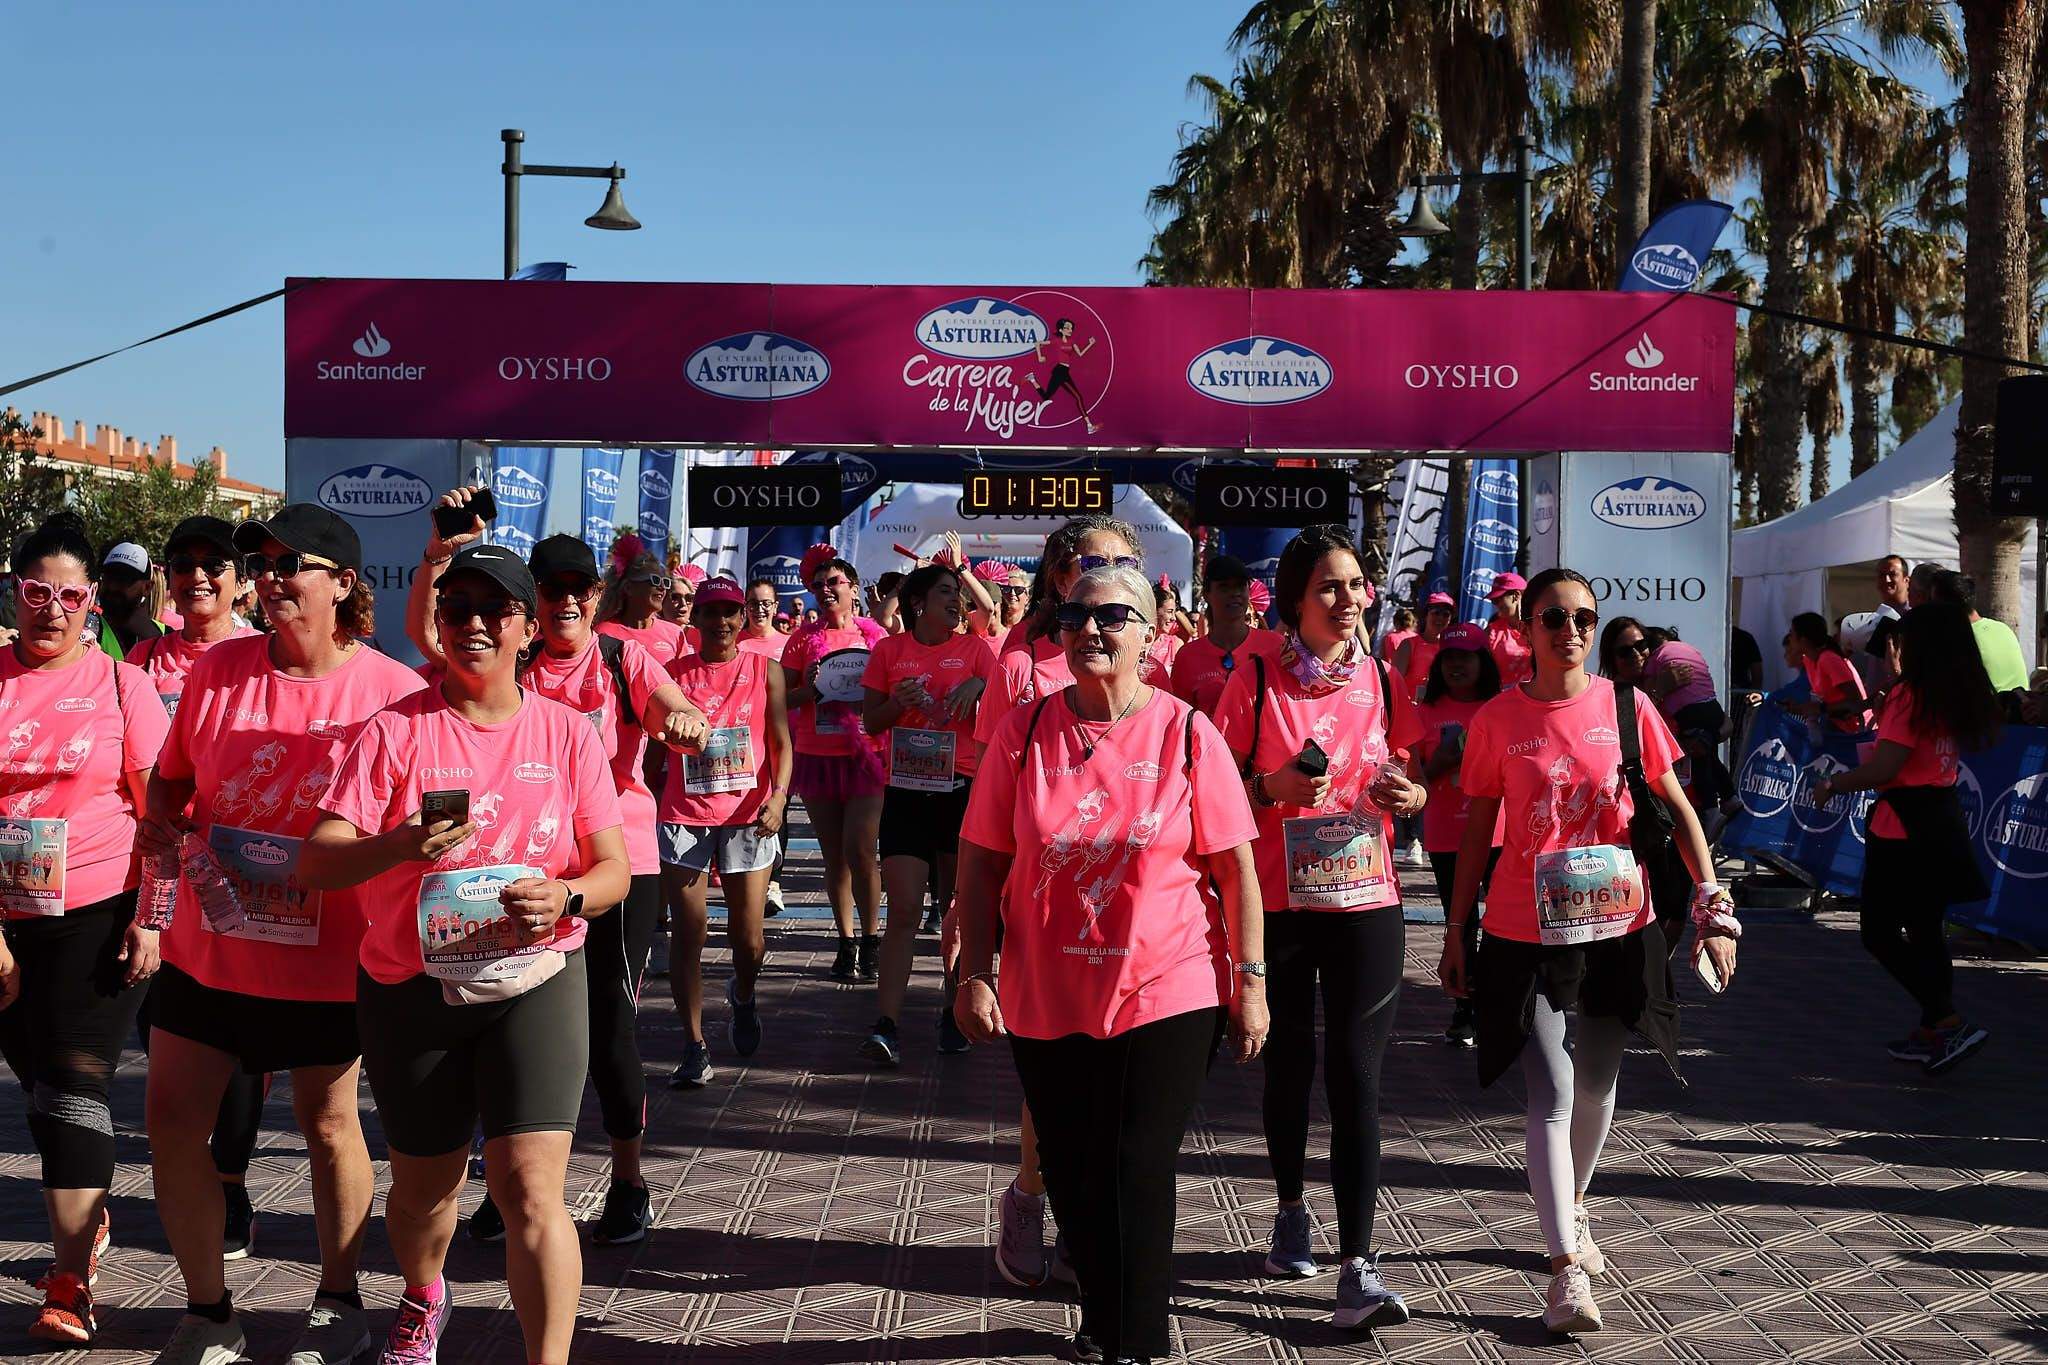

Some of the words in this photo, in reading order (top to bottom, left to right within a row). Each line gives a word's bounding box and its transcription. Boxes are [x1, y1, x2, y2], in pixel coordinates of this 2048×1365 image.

[926, 319, 1038, 344] ASTURIANA
[317, 360, 425, 381] Santander
[498, 356, 612, 382] OYSHO
[695, 356, 819, 382] ASTURIANA
[902, 353, 1013, 388] Carrera
[1199, 361, 1321, 387] ASTURIANA
[1404, 364, 1519, 389] OYSHO
[1589, 372, 1699, 391] Santander
[929, 388, 949, 411] de
[954, 388, 969, 411] la
[965, 386, 1053, 439] Mujer
[326, 483, 425, 504] ASTURIANA
[713, 485, 821, 508] OYSHO
[1219, 485, 1327, 509] OYSHO
[1599, 496, 1697, 516] ASTURIANA
[876, 523, 917, 533] OYSHO
[1588, 576, 1706, 601] OYSHO
[1507, 736, 1548, 756] OYSHO
[421, 767, 473, 780] OYSHO
[1039, 766, 1085, 777] OYSHO
[242, 845, 285, 861] ASTURIANA
[1321, 855, 1358, 872] 016
[1567, 861, 1606, 872] ASTURIANA
[28, 890, 56, 898] VALENCIA
[1571, 887, 1611, 906] 016
[280, 916, 311, 926] VALENCIA
[464, 915, 512, 942] 016
[1552, 929, 1585, 939] OYSHO
[430, 953, 462, 962] CARRERA
[463, 953, 473, 961] DE
[475, 952, 484, 960] LA
[485, 949, 509, 959] MUJER
[514, 944, 546, 955] VALENCIA
[1062, 946, 1089, 955] CARRERA
[1107, 948, 1129, 956] MUJER
[1087, 956, 1103, 964] 2024
[439, 965, 479, 975] OYSHO
